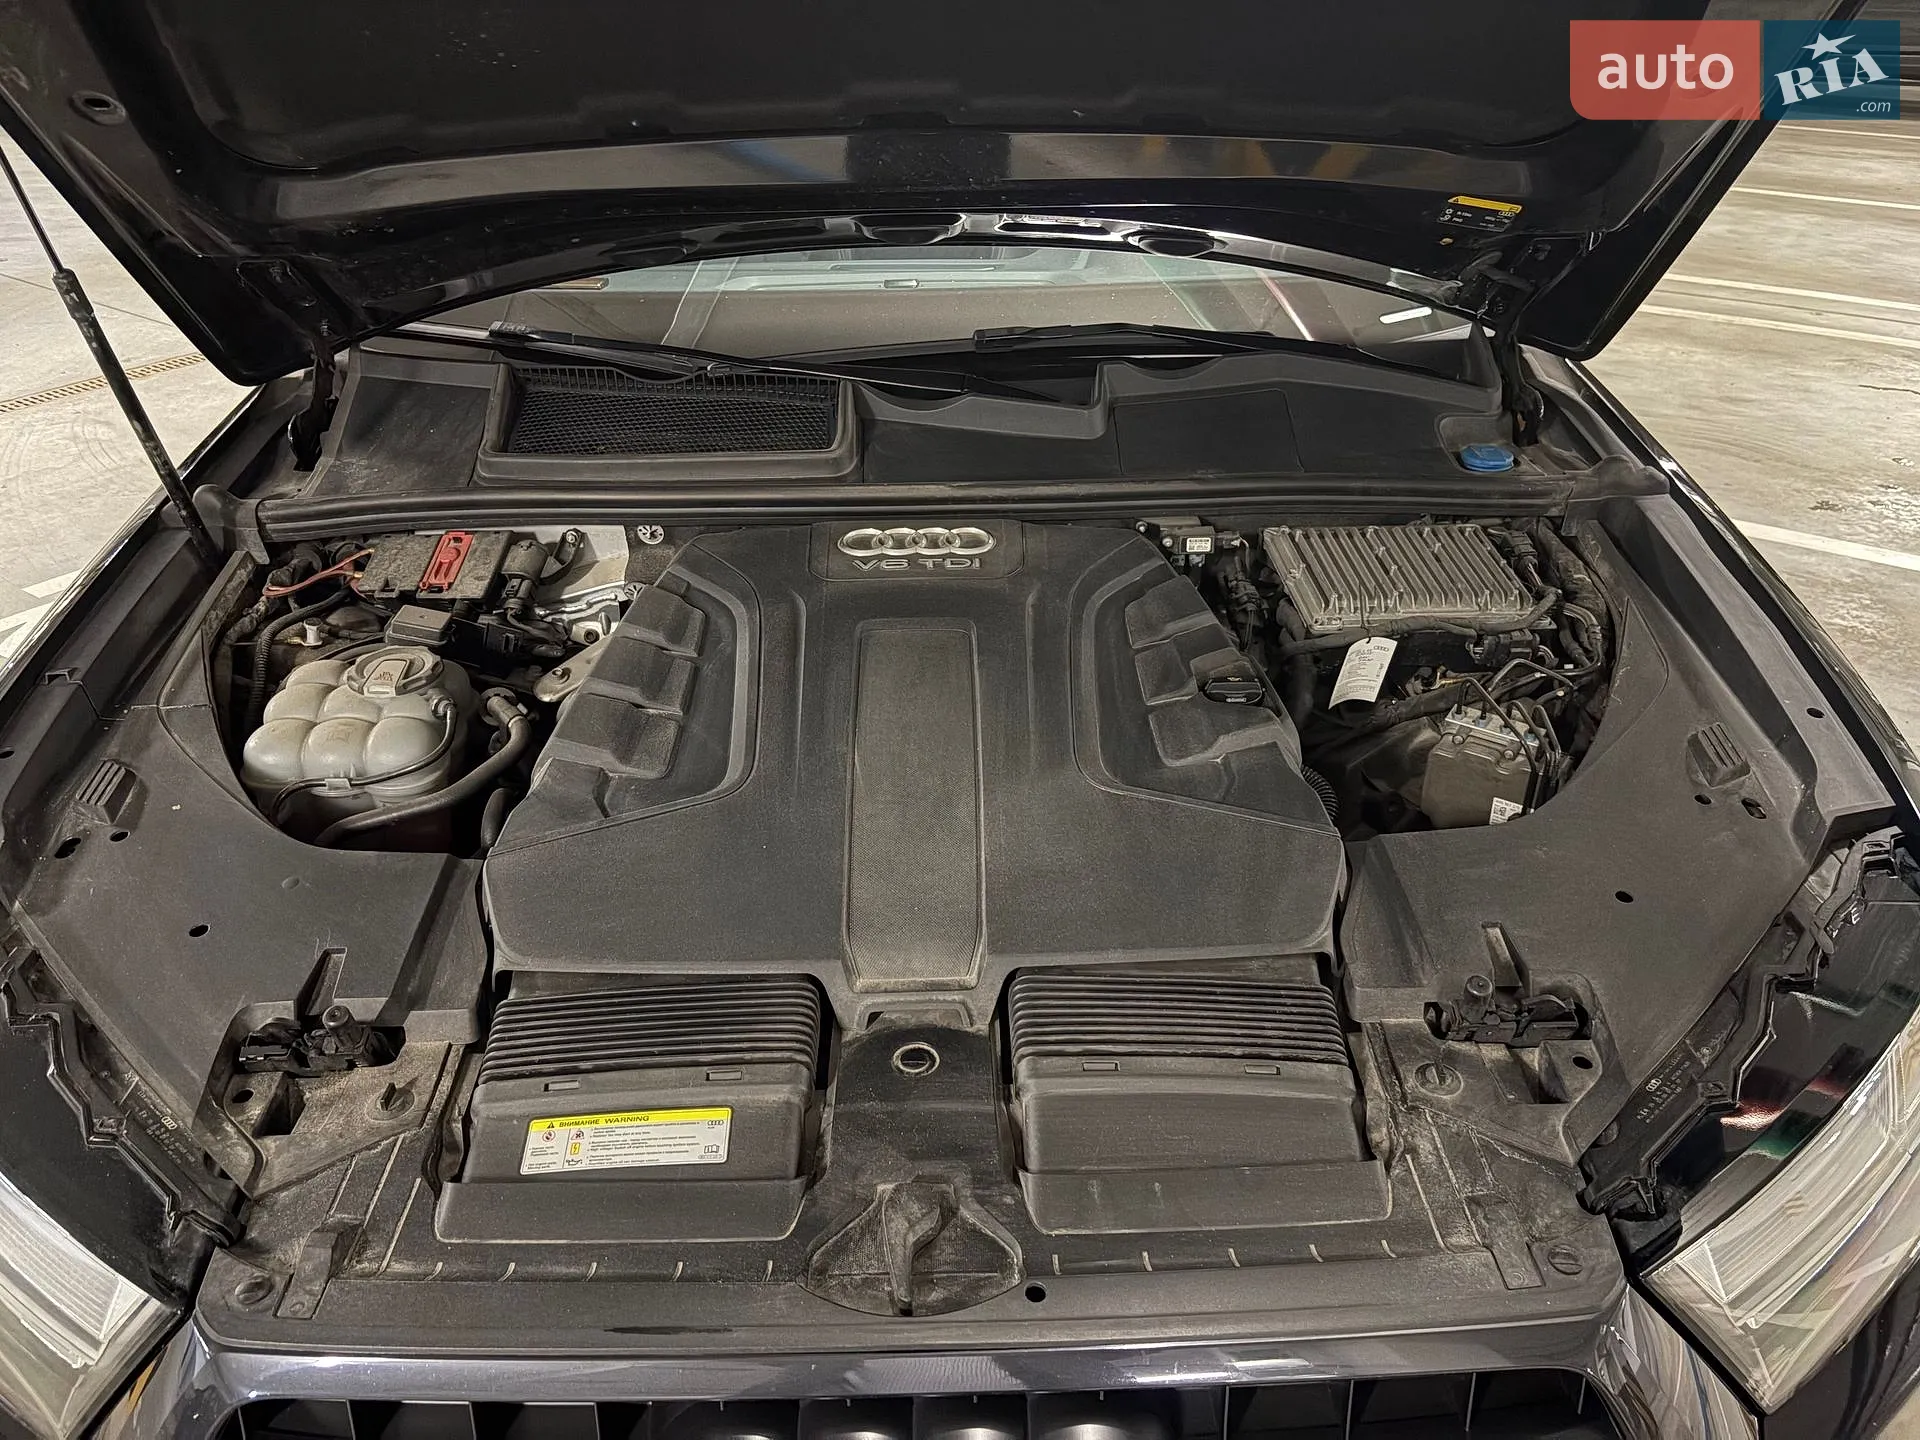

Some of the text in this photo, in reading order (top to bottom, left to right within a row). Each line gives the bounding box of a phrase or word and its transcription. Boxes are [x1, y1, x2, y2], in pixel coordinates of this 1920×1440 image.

[852, 558, 981, 571] V6 TDI
[559, 1118, 600, 1128] ВНИМАНИЕ
[604, 1115, 650, 1124] WARNING
